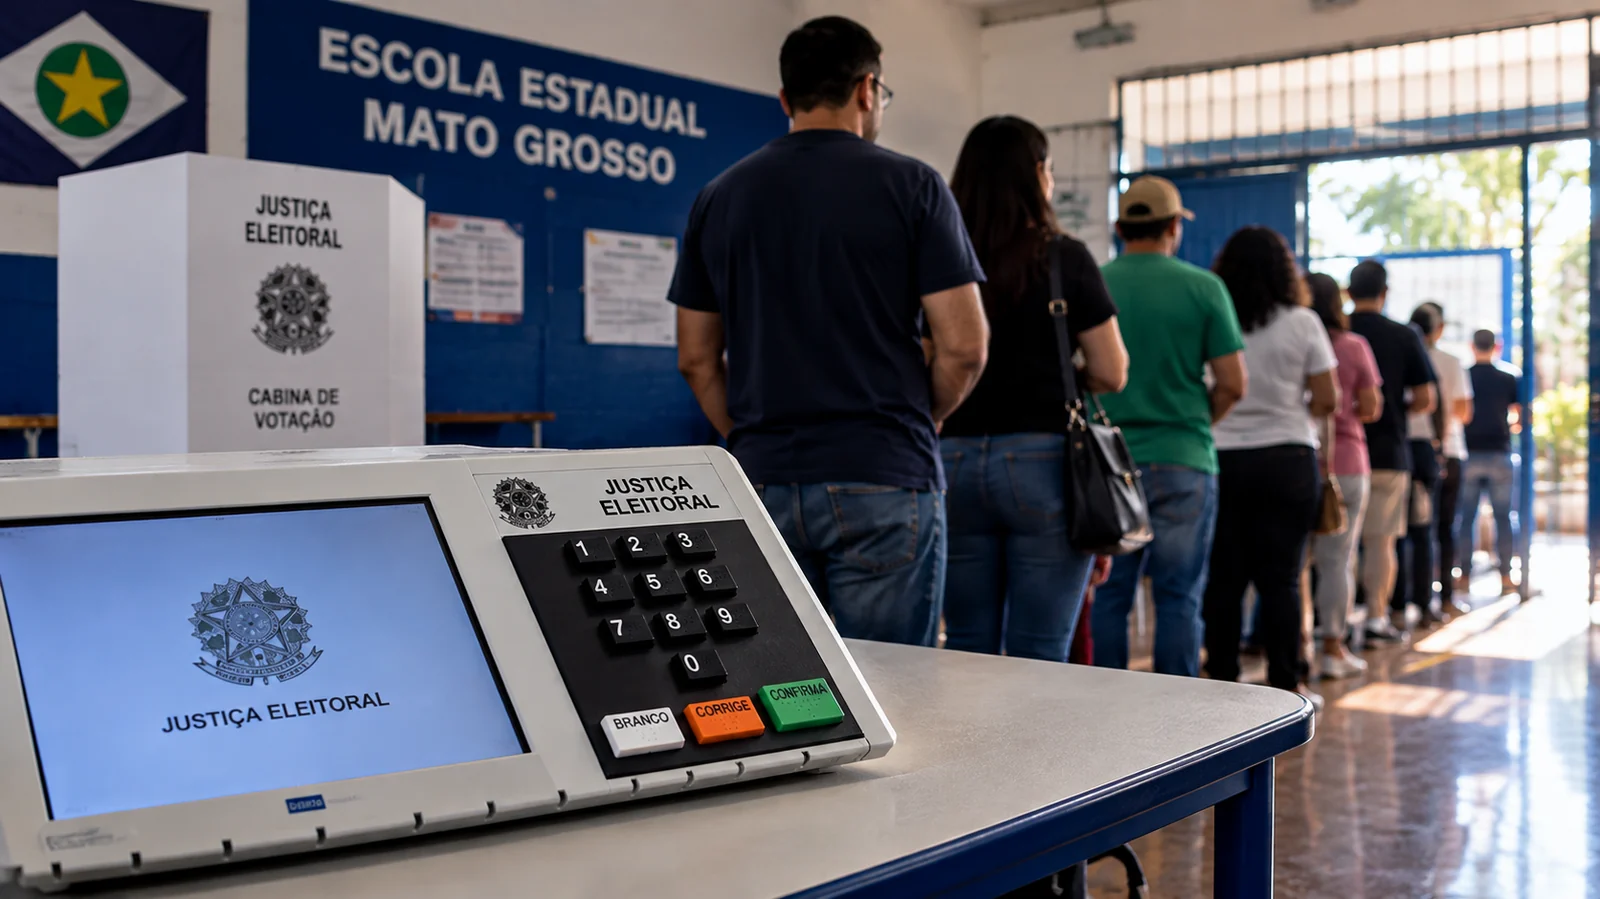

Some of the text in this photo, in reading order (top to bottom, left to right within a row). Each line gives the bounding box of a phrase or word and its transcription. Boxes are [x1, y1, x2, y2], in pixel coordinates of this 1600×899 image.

[319, 27, 707, 139] ESCOLA ESTADUAL
[364, 99, 676, 185] MATO GROSSO
[256, 194, 332, 223] JUSTIÇA
[245, 221, 343, 249] ELEITORAL
[248, 387, 340, 406] CABINA DE
[604, 476, 693, 495] JUSTIÇA
[599, 494, 719, 517] ELEITORAL
[576, 532, 693, 557] 1 2 3
[594, 569, 713, 595] 4 5 6
[610, 607, 733, 636] 7 8 9
[683, 654, 700, 672] 0
[769, 682, 827, 701] CONFIRMA
[162, 691, 390, 733] JUSTIÇA ELEITORAL
[613, 711, 669, 729] BRANCO
[695, 699, 751, 718] CORRIGE
